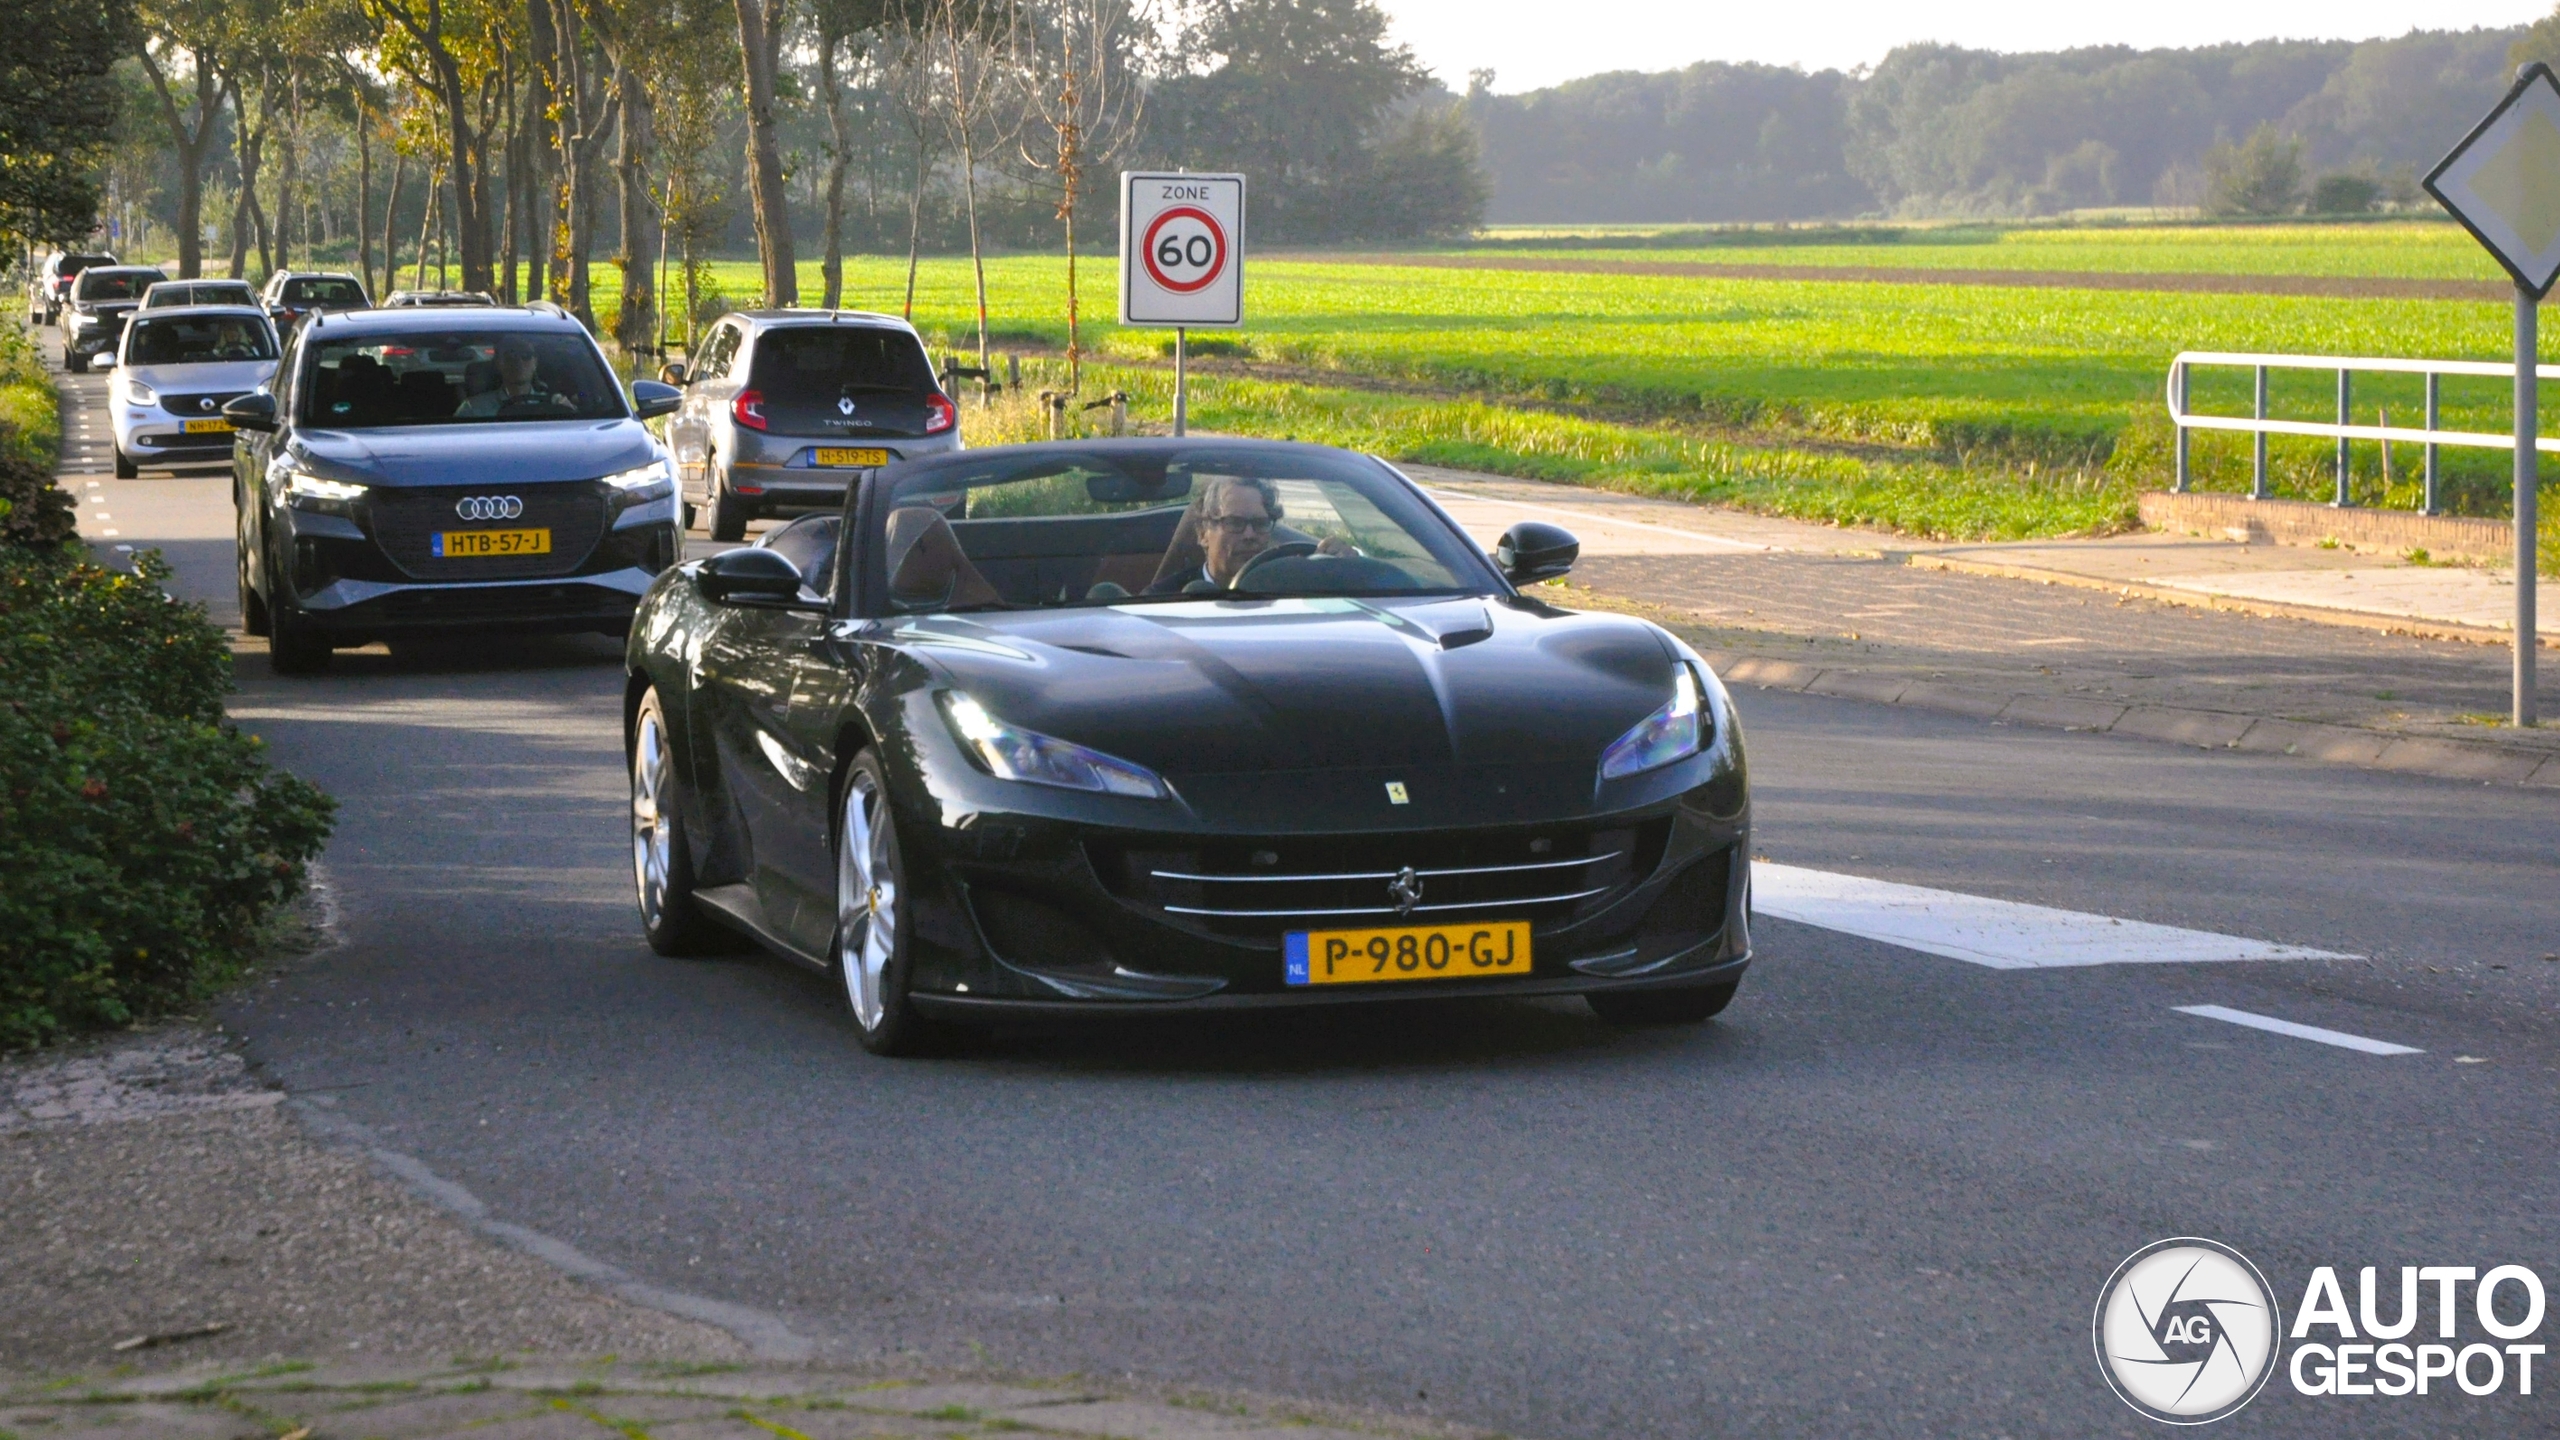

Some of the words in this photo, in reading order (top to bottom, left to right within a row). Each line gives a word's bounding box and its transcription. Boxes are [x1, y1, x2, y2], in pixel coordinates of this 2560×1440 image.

[1162, 186, 1210, 200] ZONE
[1158, 235, 1212, 267] 60
[823, 419, 873, 427] TWINGO
[821, 450, 881, 464] H-519-TS
[451, 533, 540, 553] HTB-57-J
[1326, 929, 1514, 975] P-980-GJ
[1289, 964, 1306, 976] NL
